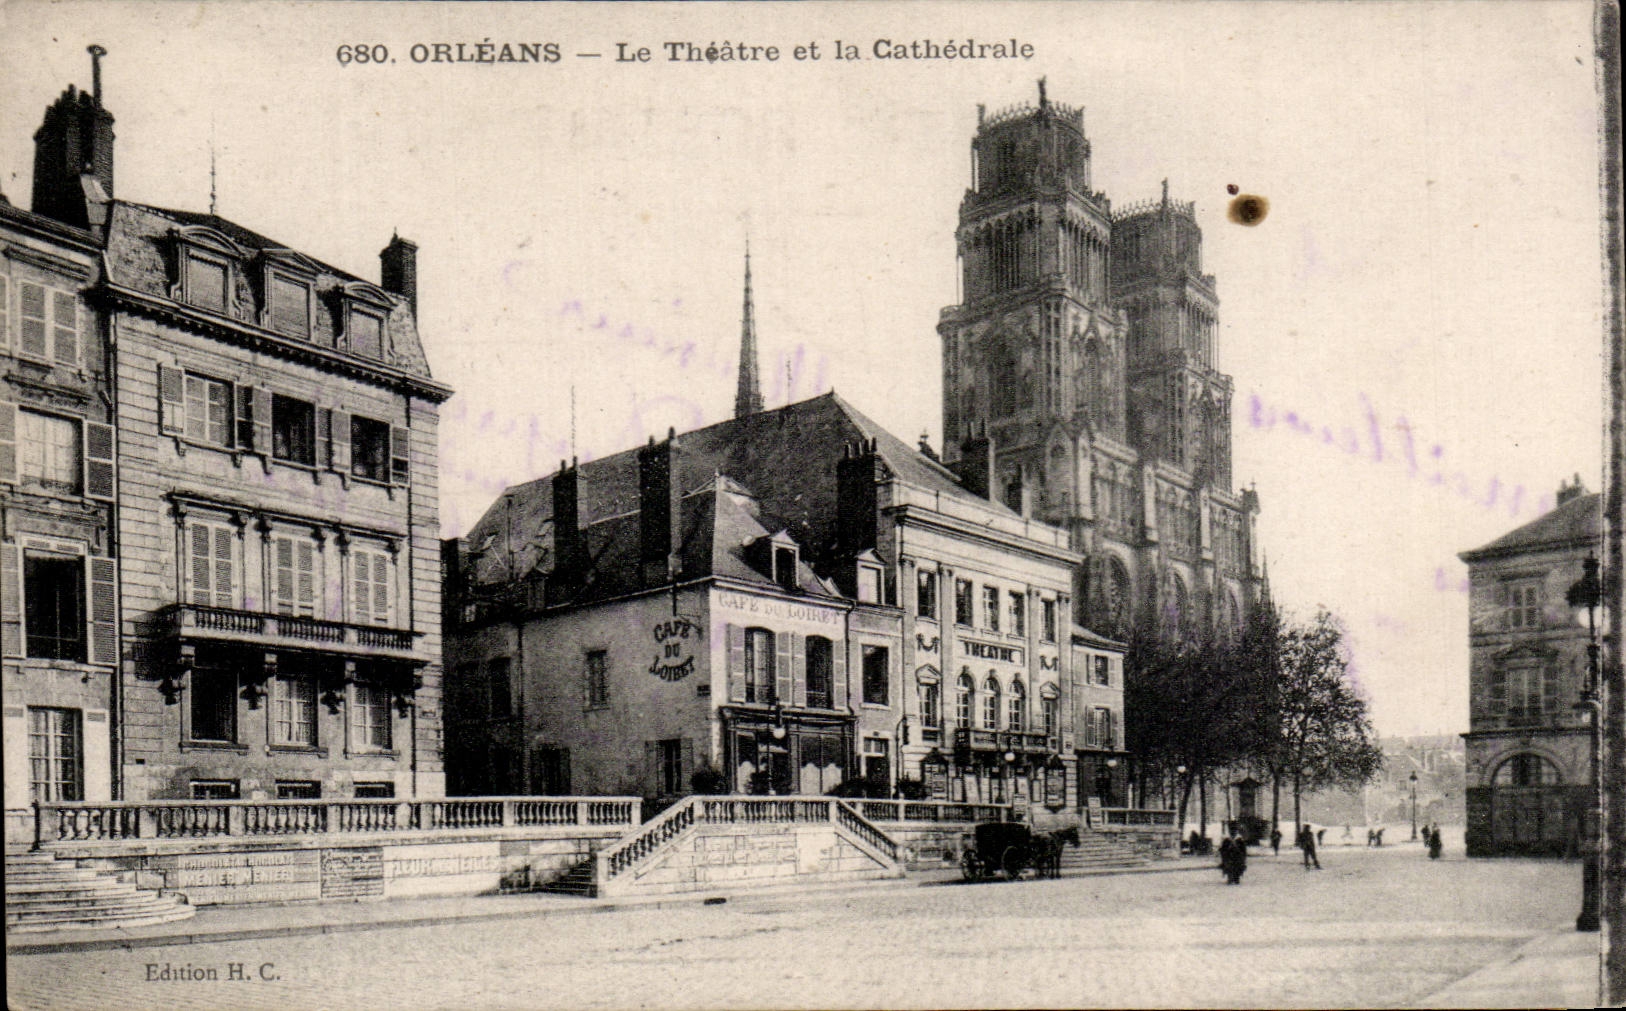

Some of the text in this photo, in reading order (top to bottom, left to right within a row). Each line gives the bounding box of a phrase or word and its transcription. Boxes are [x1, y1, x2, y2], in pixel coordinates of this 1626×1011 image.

[788, 603, 840, 625] LOIRET
[664, 642, 681, 659] DU
[648, 654, 695, 682] LOIRET
